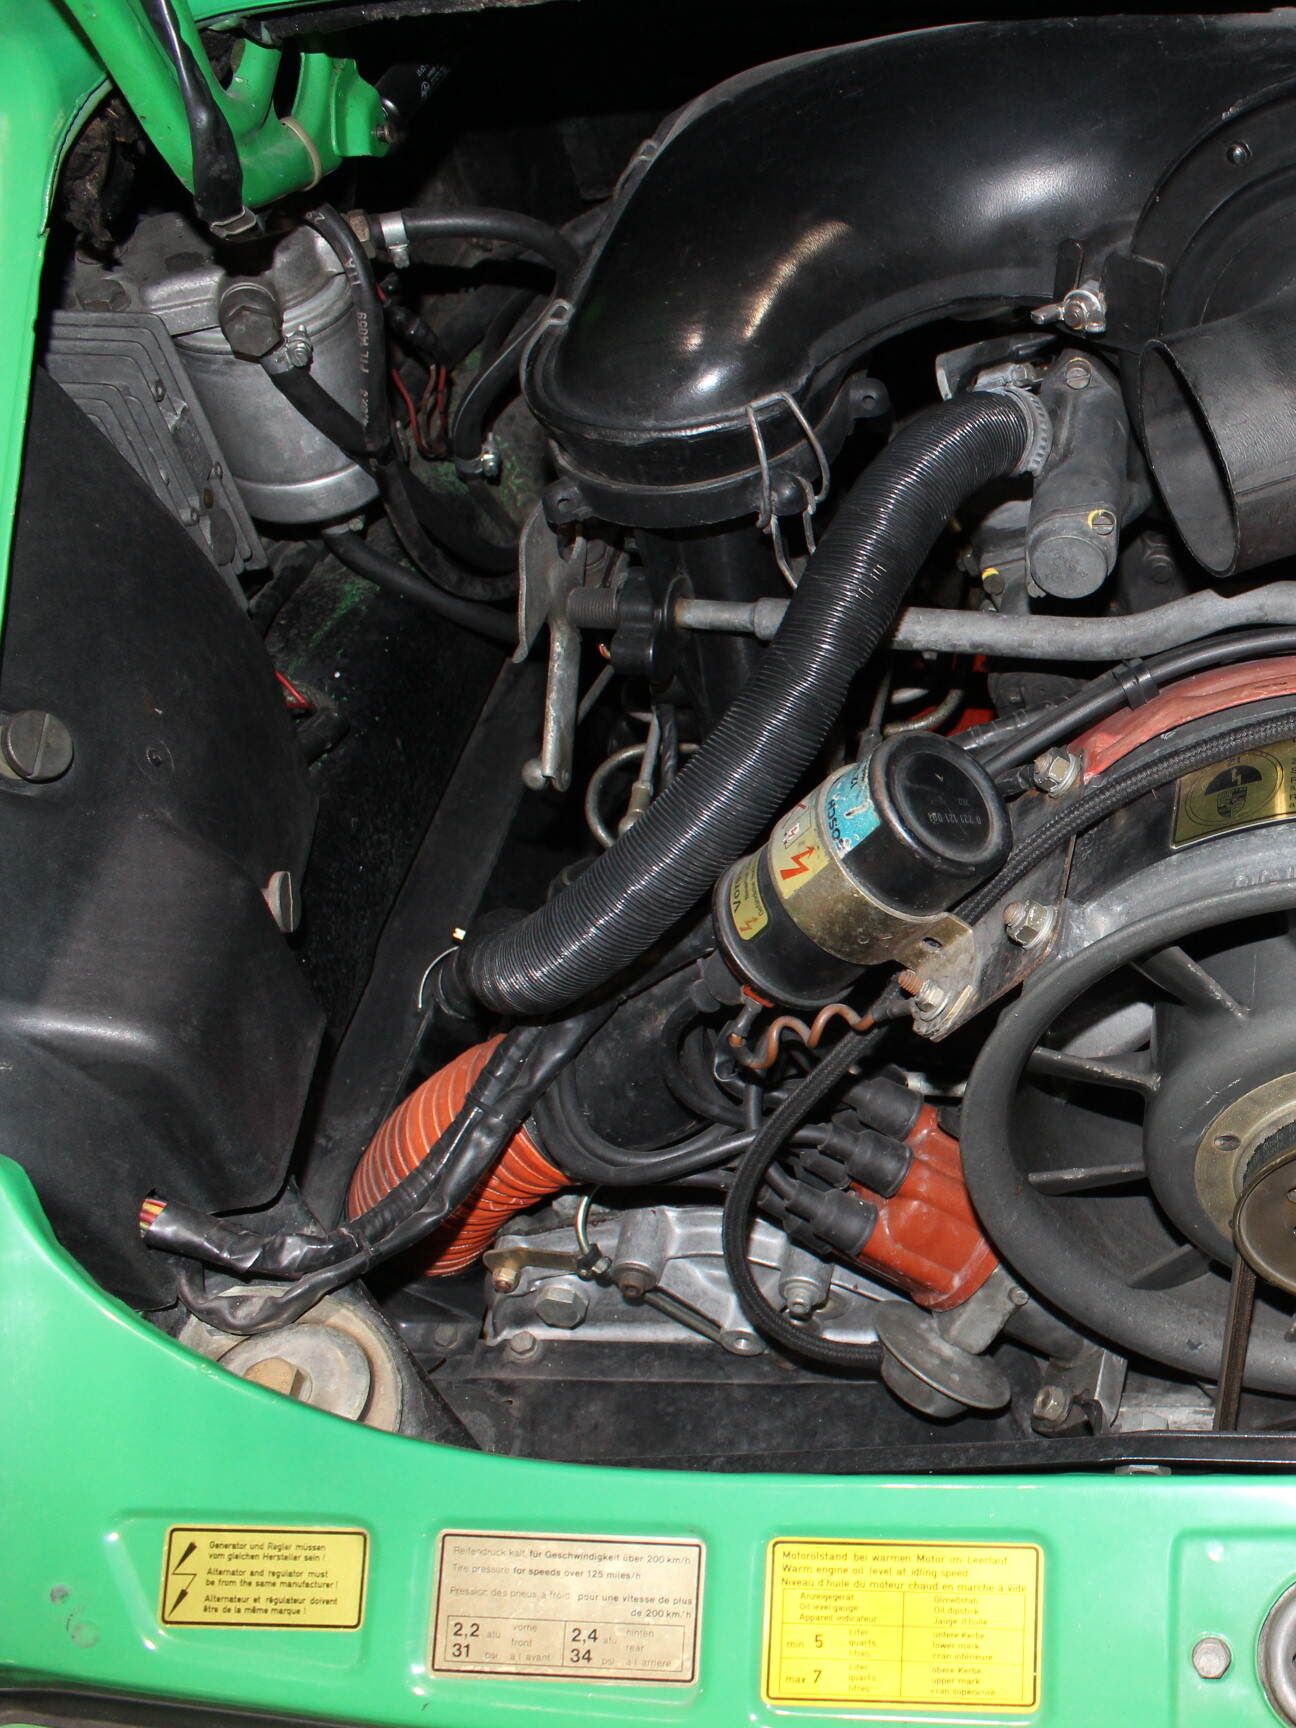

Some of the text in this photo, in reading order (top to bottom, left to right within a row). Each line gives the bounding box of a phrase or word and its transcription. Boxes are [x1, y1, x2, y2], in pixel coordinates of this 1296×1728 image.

[209, 1541, 248, 1550] Generator
[267, 1543, 293, 1552] Regler
[227, 1552, 260, 1562] gleichen
[263, 1553, 302, 1561] Hersteller
[544, 1550, 620, 1563] Geschwindigkeit
[853, 1552, 868, 1562] bei
[872, 1554, 911, 1563] warmen
[916, 1554, 945, 1564] Motor
[206, 1568, 247, 1577] Alternator
[249, 1569, 265, 1577] and
[268, 1570, 304, 1579] regulator
[513, 1567, 525, 1575] for
[529, 1567, 561, 1576] speeds
[564, 1570, 584, 1578] over
[587, 1570, 603, 1578] 125
[606, 1571, 641, 1579] miles/h
[782, 1564, 813, 1574] Warm
[816, 1566, 849, 1576] engine
[869, 1566, 892, 1576] level
[896, 1567, 906, 1576] at
[911, 1567, 938, 1578] idling
[941, 1569, 969, 1578] speed
[205, 1579, 216, 1587] be
[218, 1579, 238, 1587] from
[240, 1579, 253, 1587] the
[255, 1580, 277, 1588] same
[781, 1578, 815, 1587] Niveau
[854, 1580, 866, 1589] du
[869, 1581, 904, 1590] moteur
[908, 1581, 939, 1591] chaud
[957, 1583, 995, 1592] marche
[1007, 1584, 1028, 1593] vide
[204, 1595, 250, 1604] Alternateur
[253, 1596, 261, 1604] et
[310, 1597, 339, 1605] doivent
[491, 1589, 508, 1597] des
[577, 1593, 599, 1602] pour
[602, 1594, 619, 1602] une
[622, 1594, 656, 1603] vitesse
[658, 1595, 670, 1604] de
[673, 1597, 693, 1606] plus
[270, 1608, 301, 1616] marque
[630, 1608, 664, 1617] de 200
[452, 1622, 480, 1640] 2,2
[571, 1627, 599, 1645] 2,4
[511, 1638, 533, 1648] front
[814, 1633, 824, 1649] 5
[452, 1643, 472, 1658] 31
[570, 1648, 593, 1664] 34
[813, 1669, 823, 1684] 7
